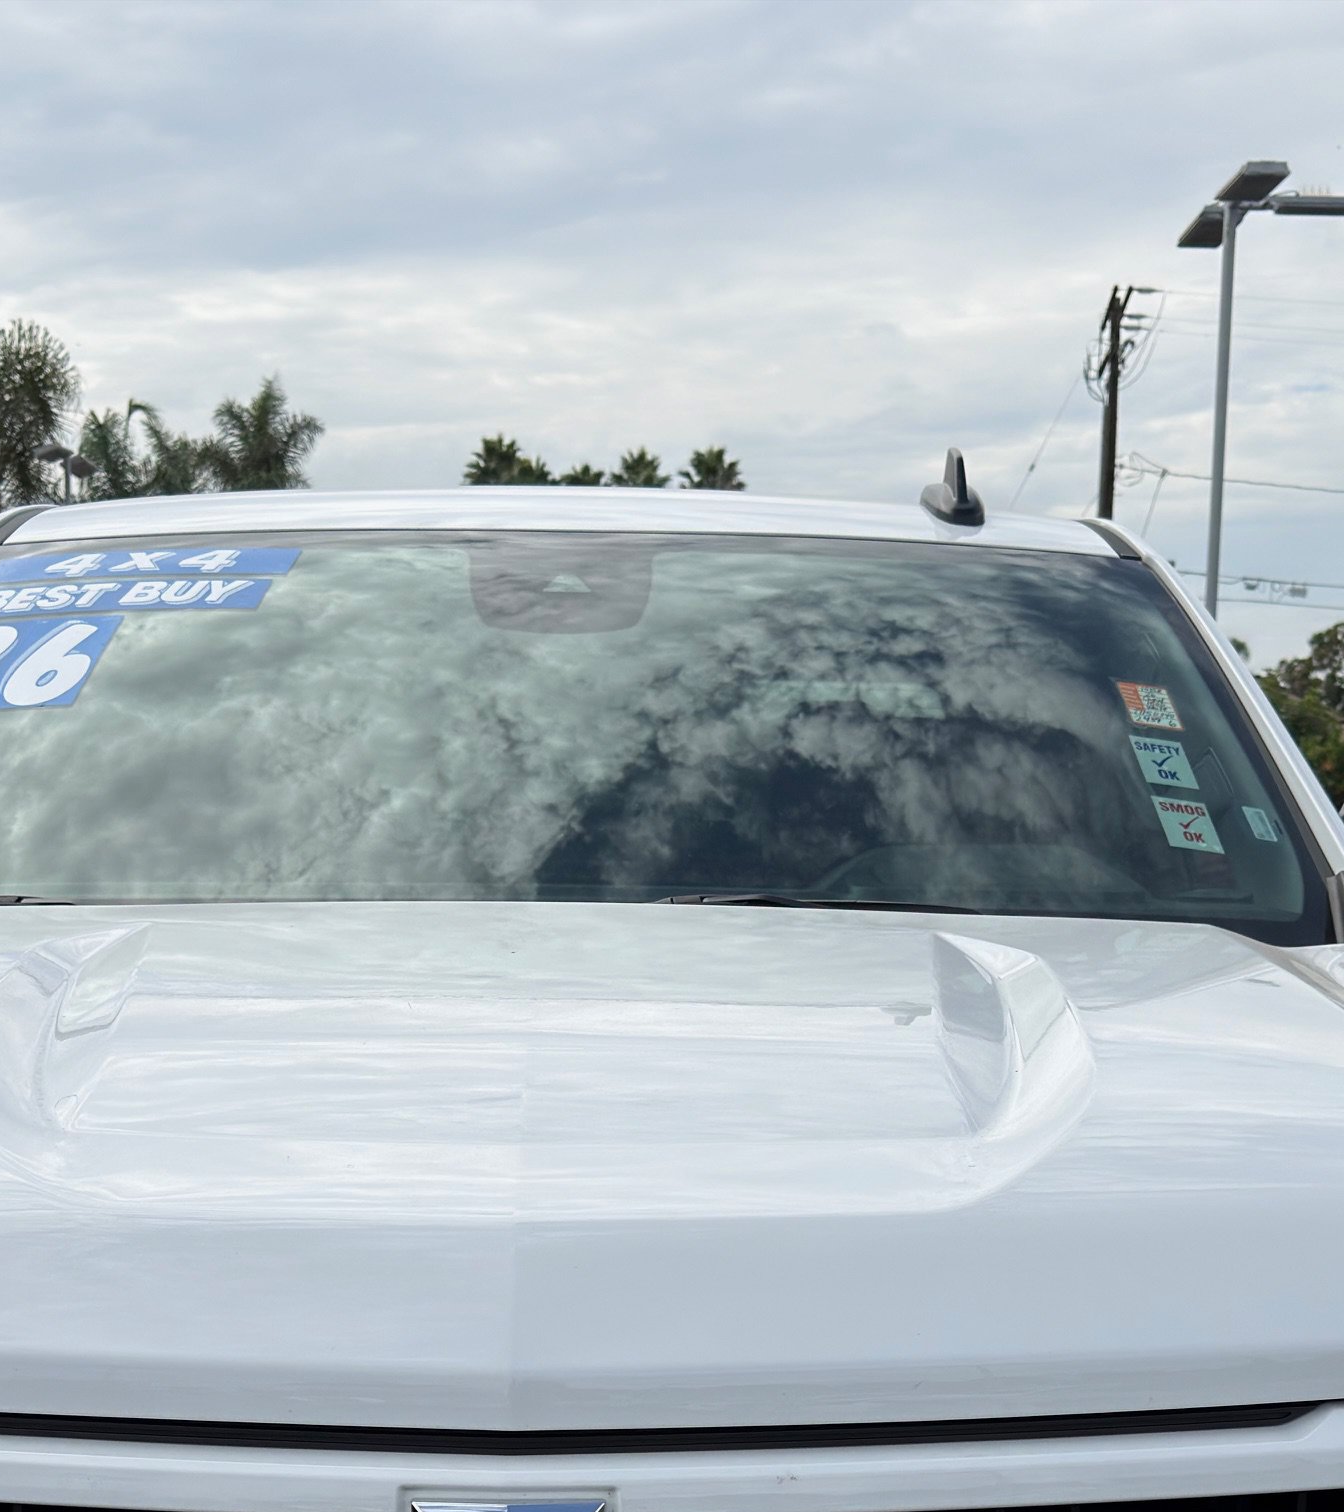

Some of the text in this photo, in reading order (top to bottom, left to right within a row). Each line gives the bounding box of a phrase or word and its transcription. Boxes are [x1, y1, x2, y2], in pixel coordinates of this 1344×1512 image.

[118, 580, 255, 606] BUY
[1134, 741, 1181, 756] SAFETY
[1157, 769, 1181, 781] OK
[1159, 801, 1206, 817] SMOG
[1183, 831, 1205, 843] OK
